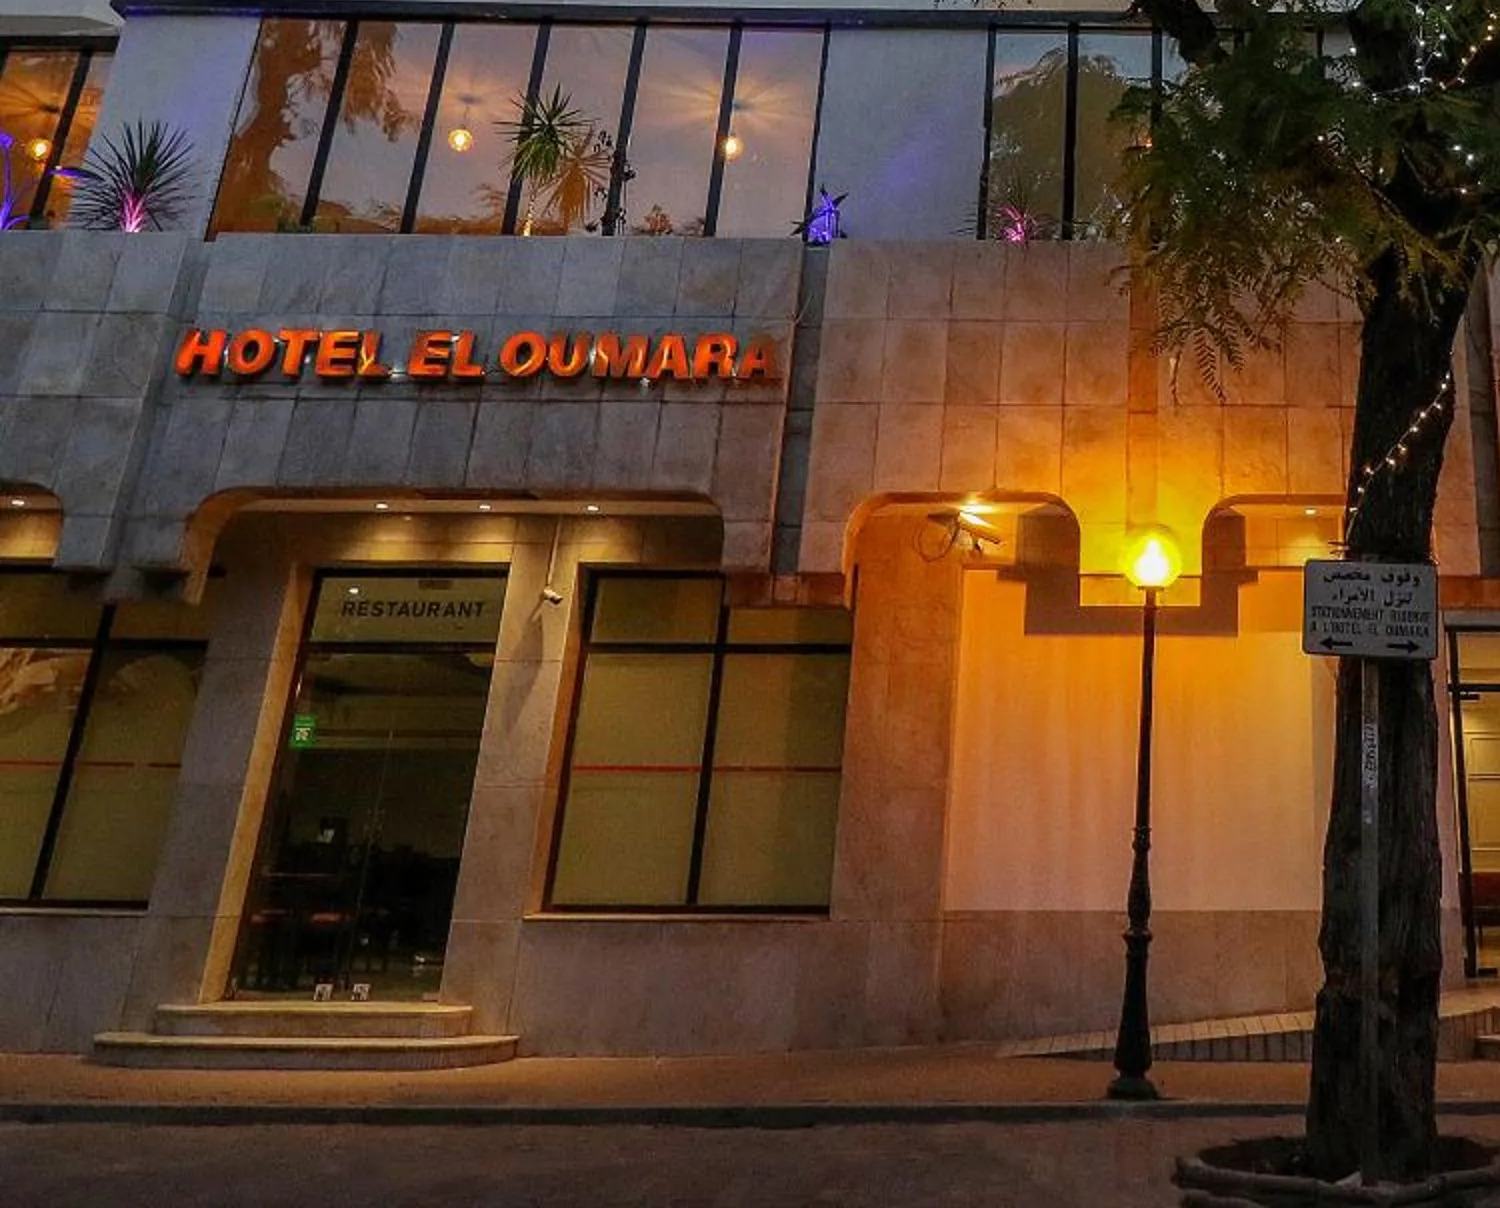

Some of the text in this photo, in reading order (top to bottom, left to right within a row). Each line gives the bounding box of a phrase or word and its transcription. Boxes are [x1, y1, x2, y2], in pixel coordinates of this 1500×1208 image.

[173, 327, 780, 380] HOTEL EL OUMARA
[341, 600, 486, 618] RESTAURANT
